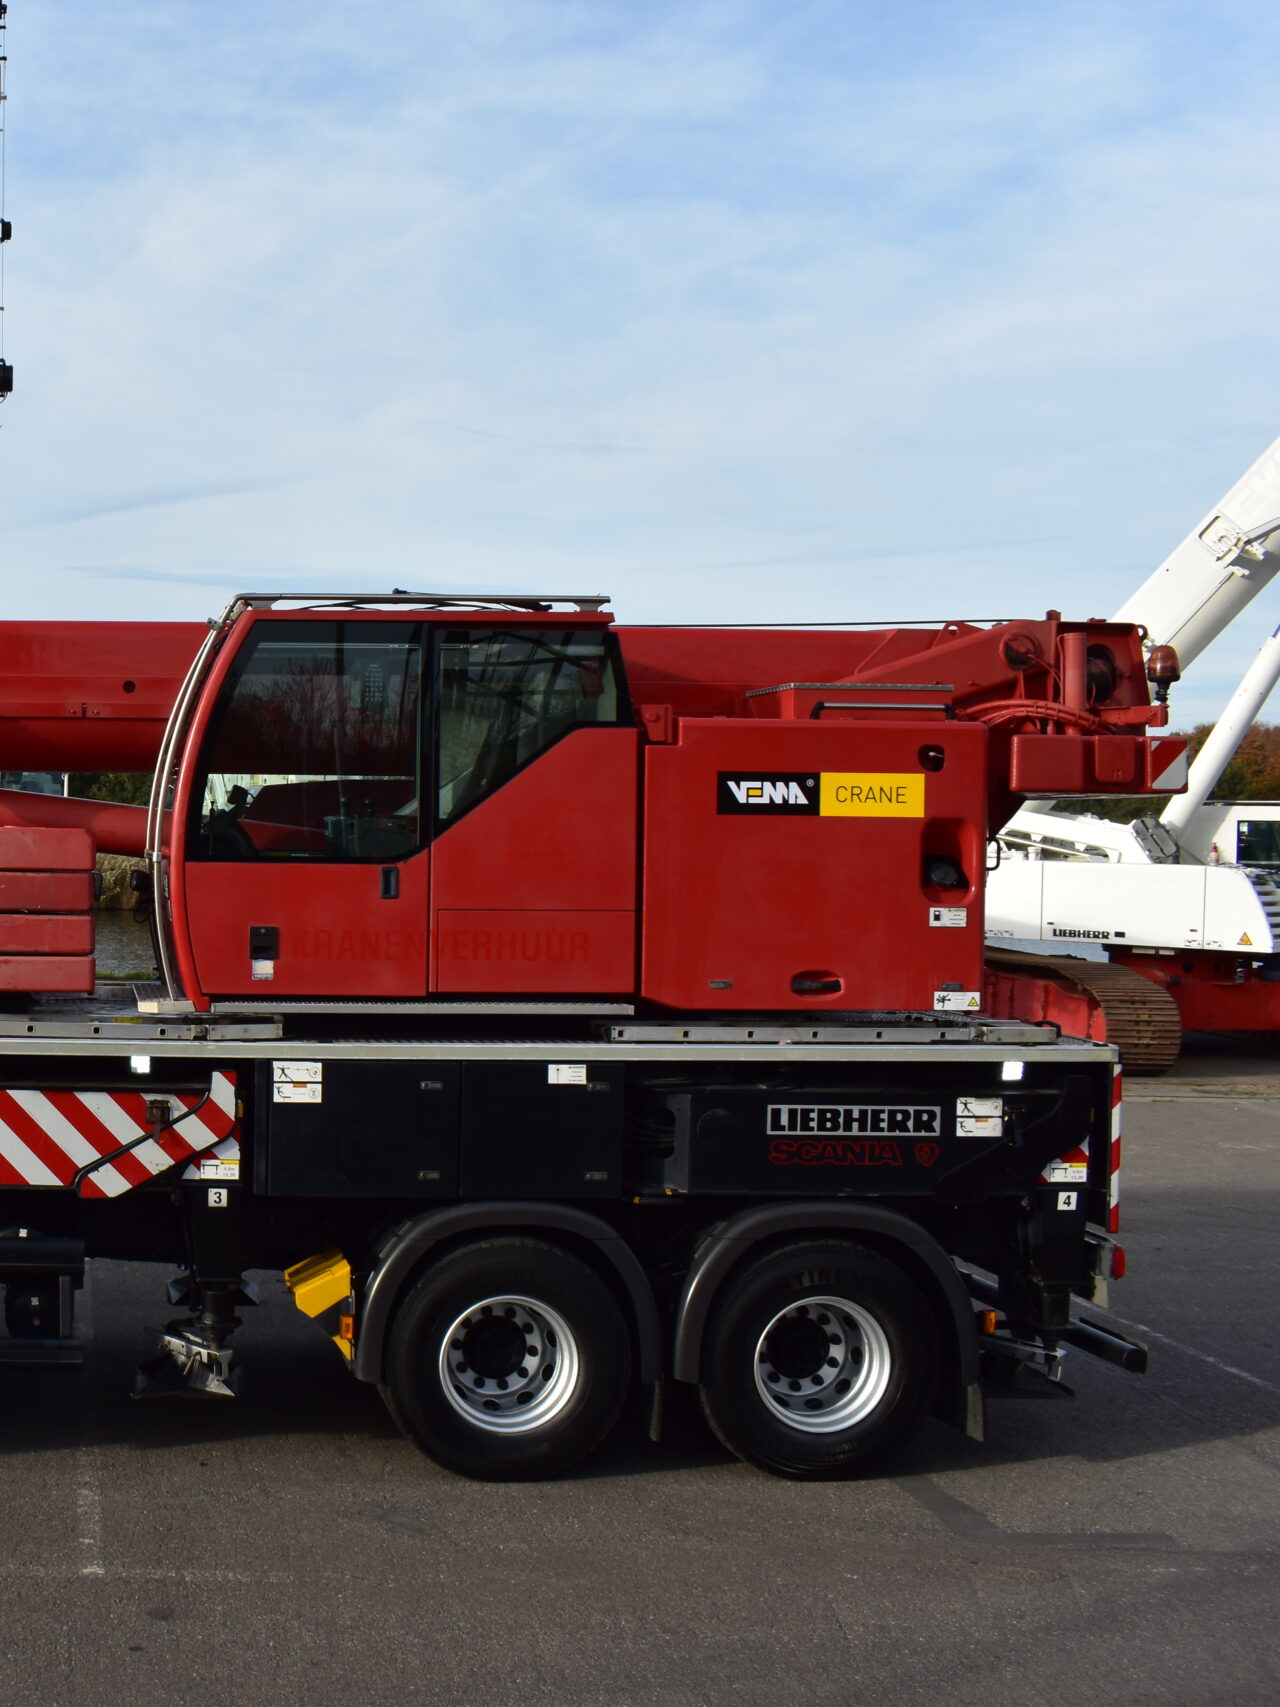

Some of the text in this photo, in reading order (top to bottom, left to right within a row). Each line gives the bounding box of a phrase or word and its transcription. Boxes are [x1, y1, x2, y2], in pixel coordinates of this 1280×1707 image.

[835, 785, 908, 804] CRANE
[1052, 928, 1110, 940] LIEBHERR
[770, 1107, 938, 1134] LIEBHERR
[769, 1139, 904, 1166] SCANIA
[213, 1191, 223, 1205] 3
[1062, 1194, 1073, 1208] 4
